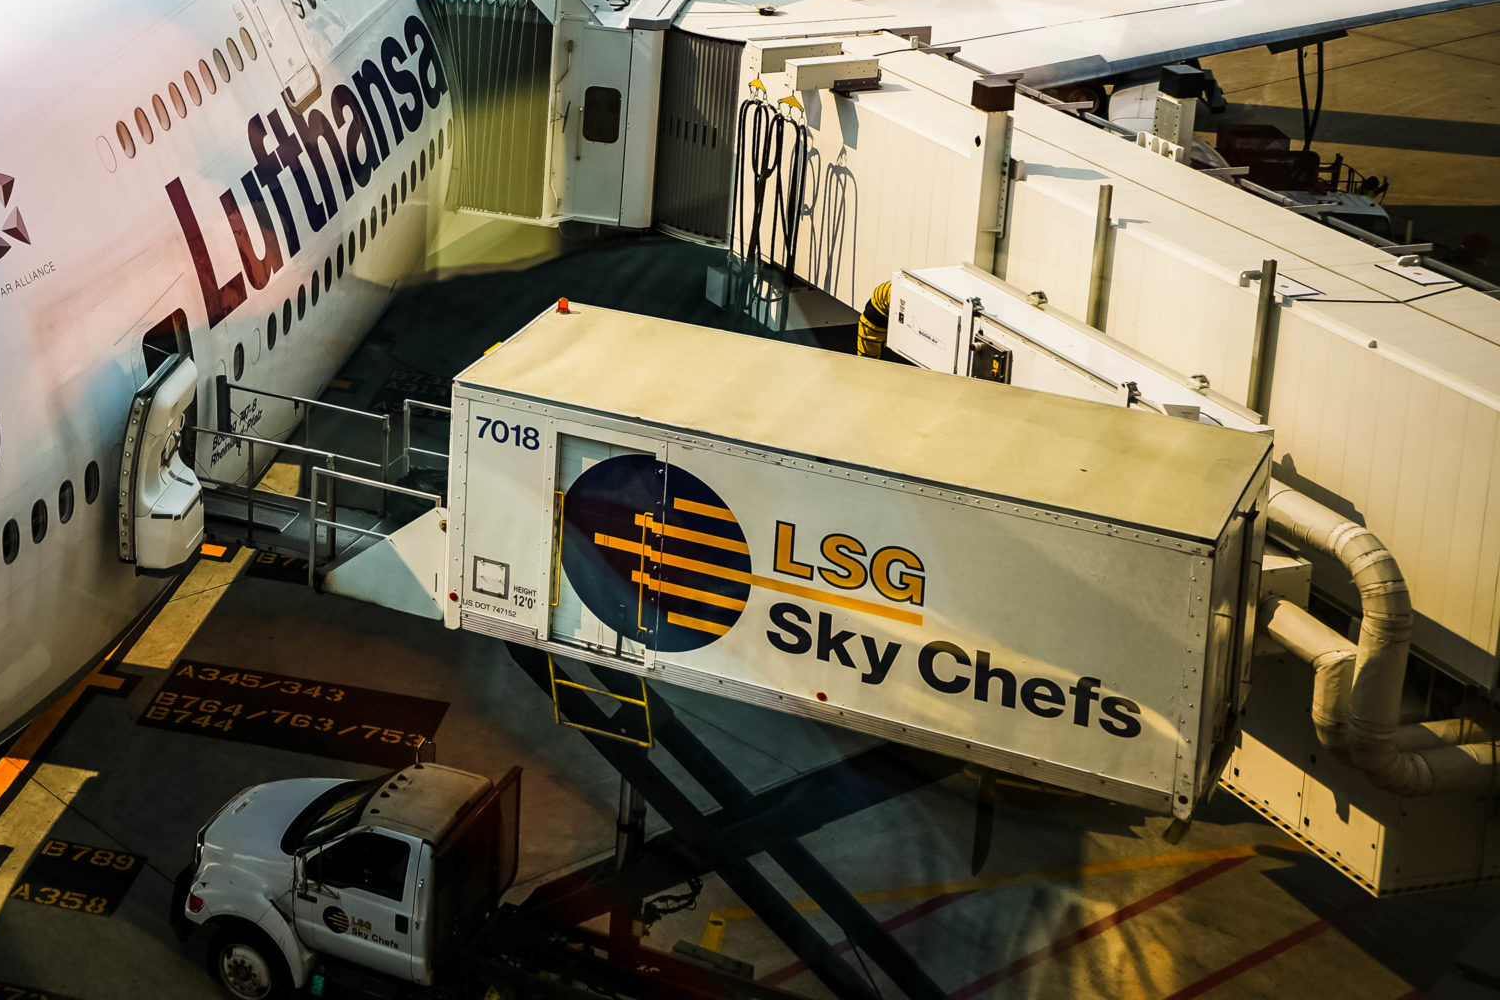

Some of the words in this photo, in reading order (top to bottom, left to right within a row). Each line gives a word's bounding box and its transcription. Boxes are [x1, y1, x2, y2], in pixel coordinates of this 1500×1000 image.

[164, 14, 449, 331] Lufthansa
[14, 261, 57, 290] ALLIANCE
[475, 415, 540, 451] 7018
[772, 519, 926, 607] LSG
[513, 585, 537, 597] HEIGHT
[463, 598, 474, 607] US
[475, 601, 491, 612] DOT
[492, 605, 517, 618] 747152
[176, 664, 347, 702] A345/343
[766, 601, 902, 686] Sky
[917, 639, 1143, 739] Chefs
[146, 705, 236, 732] B744
[41, 840, 136, 871] B789
[10, 883, 108, 914] A358
[351, 927, 370, 941] Sky
[371, 933, 399, 950] Chefs
